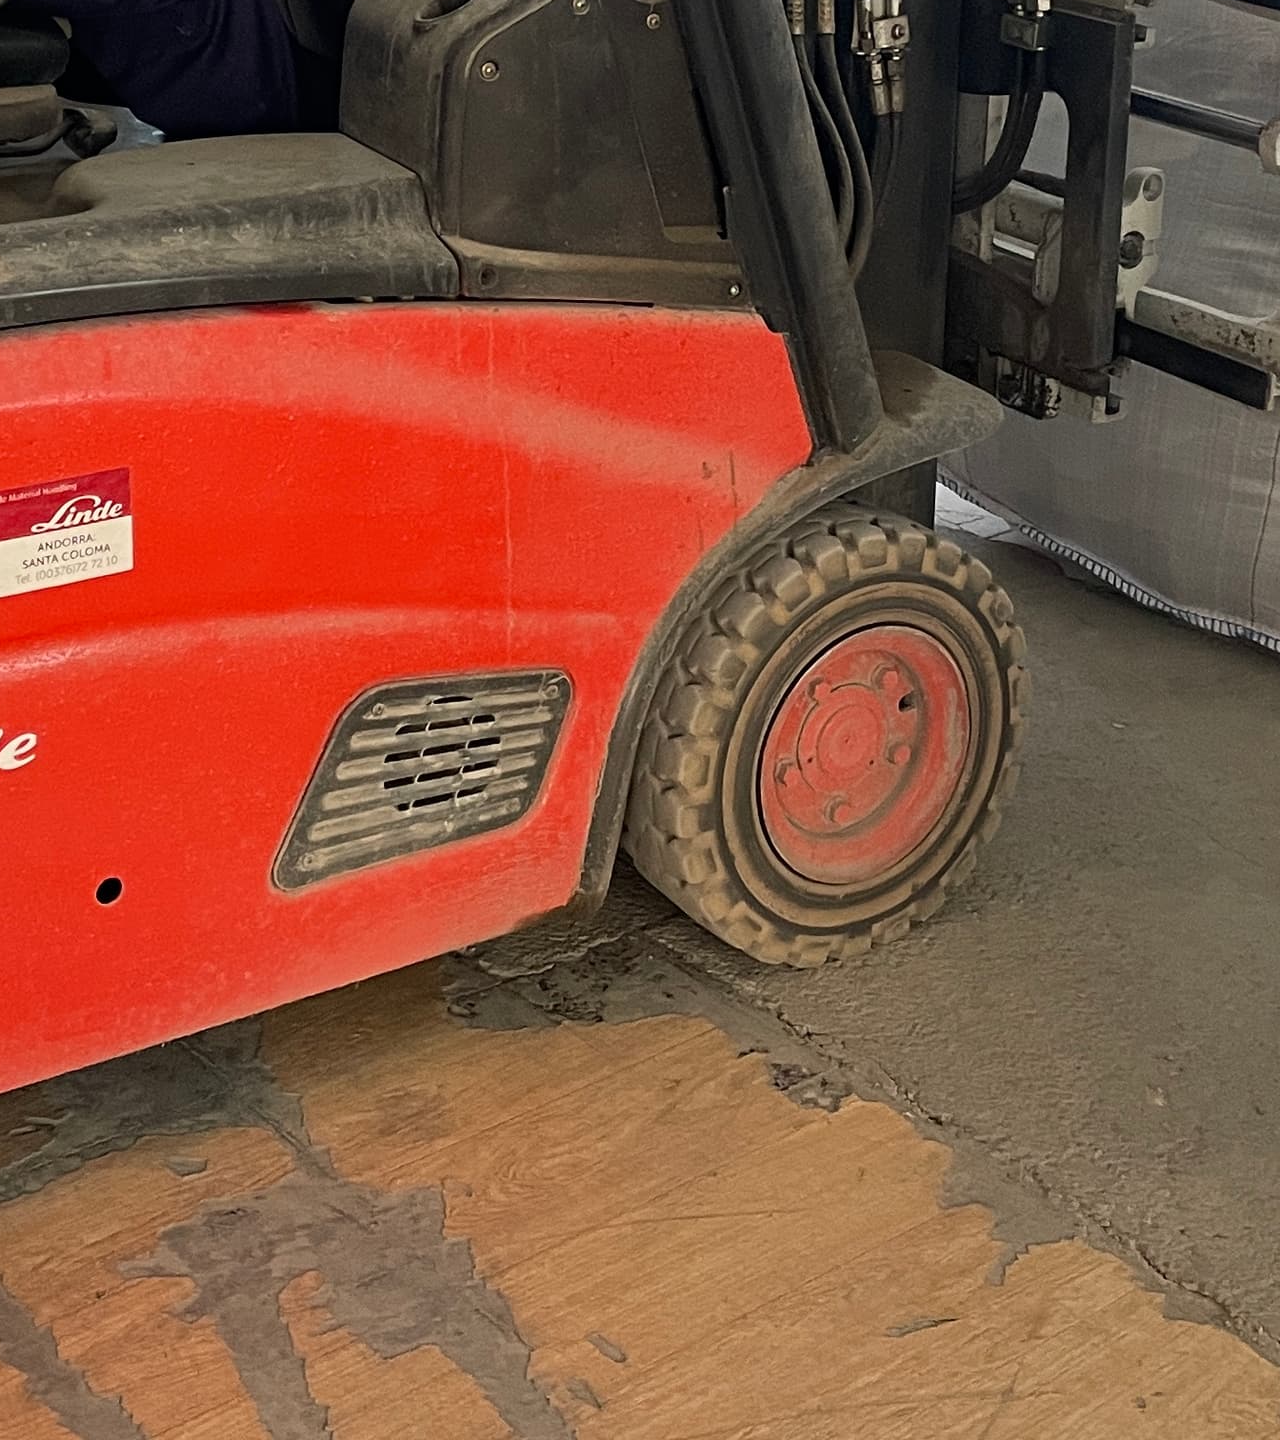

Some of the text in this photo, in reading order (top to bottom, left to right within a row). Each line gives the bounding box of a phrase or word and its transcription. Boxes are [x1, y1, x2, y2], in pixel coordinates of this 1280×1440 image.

[31, 494, 123, 533] Linde
[22, 544, 111, 569] SANTA COLOMA
[91, 558, 104, 569] 72
[106, 555, 118, 566] 10
